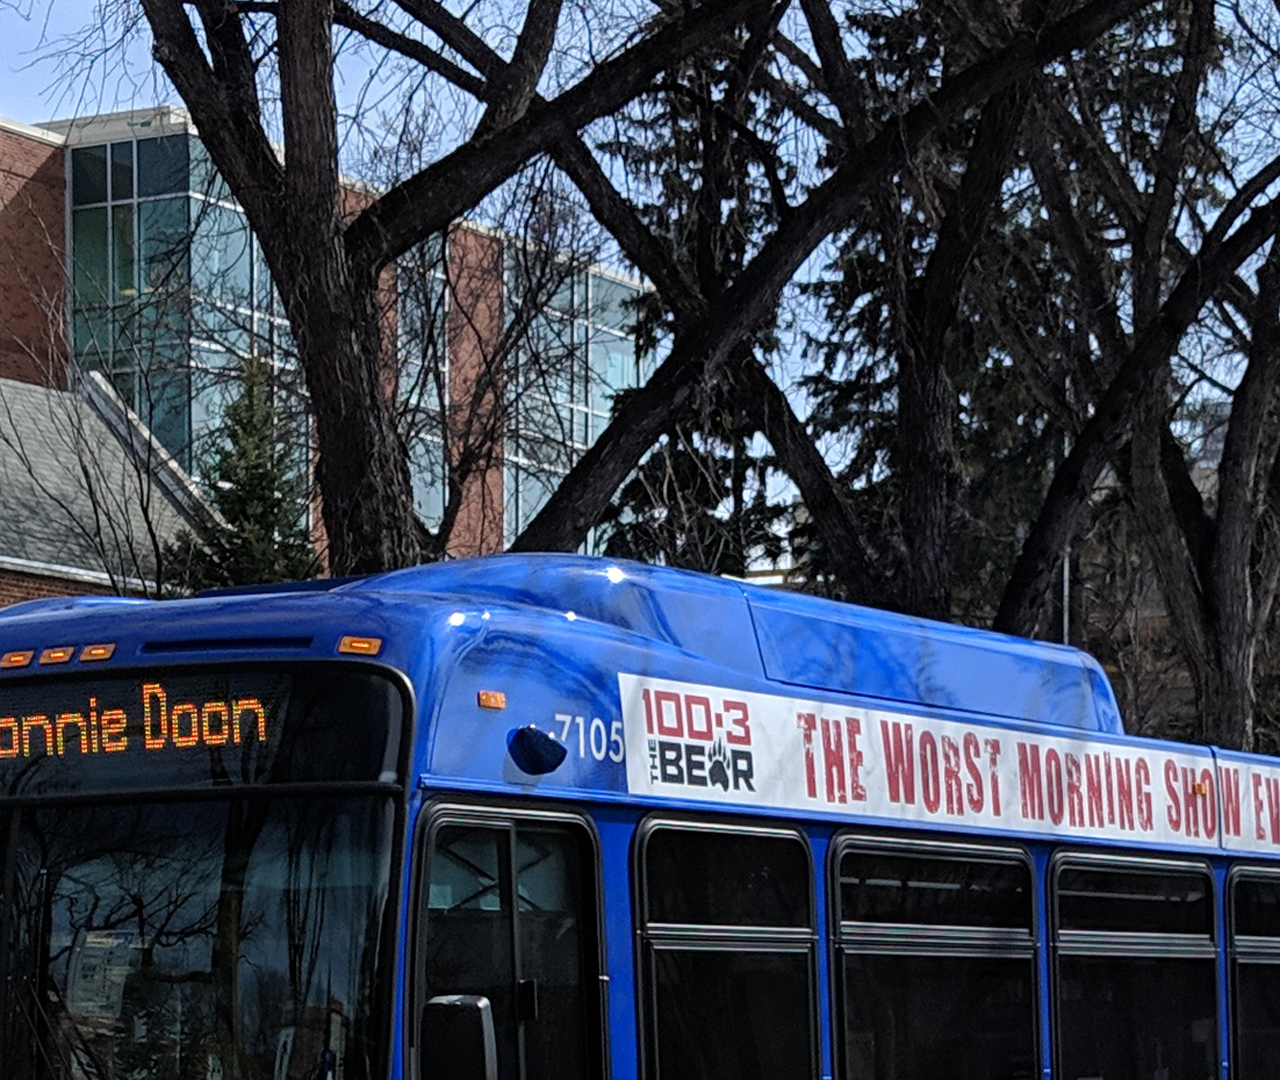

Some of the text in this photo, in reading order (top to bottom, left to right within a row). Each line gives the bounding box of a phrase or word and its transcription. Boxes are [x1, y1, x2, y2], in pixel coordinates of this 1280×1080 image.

[143, 683, 267, 749] Doon
[555, 713, 624, 763] 7105
[647, 739, 659, 785] THE
[796, 712, 867, 804] THE
[880, 720, 1001, 817] WORST
[1017, 742, 1153, 832] MORNING
[1164, 759, 1241, 840] SHOW
